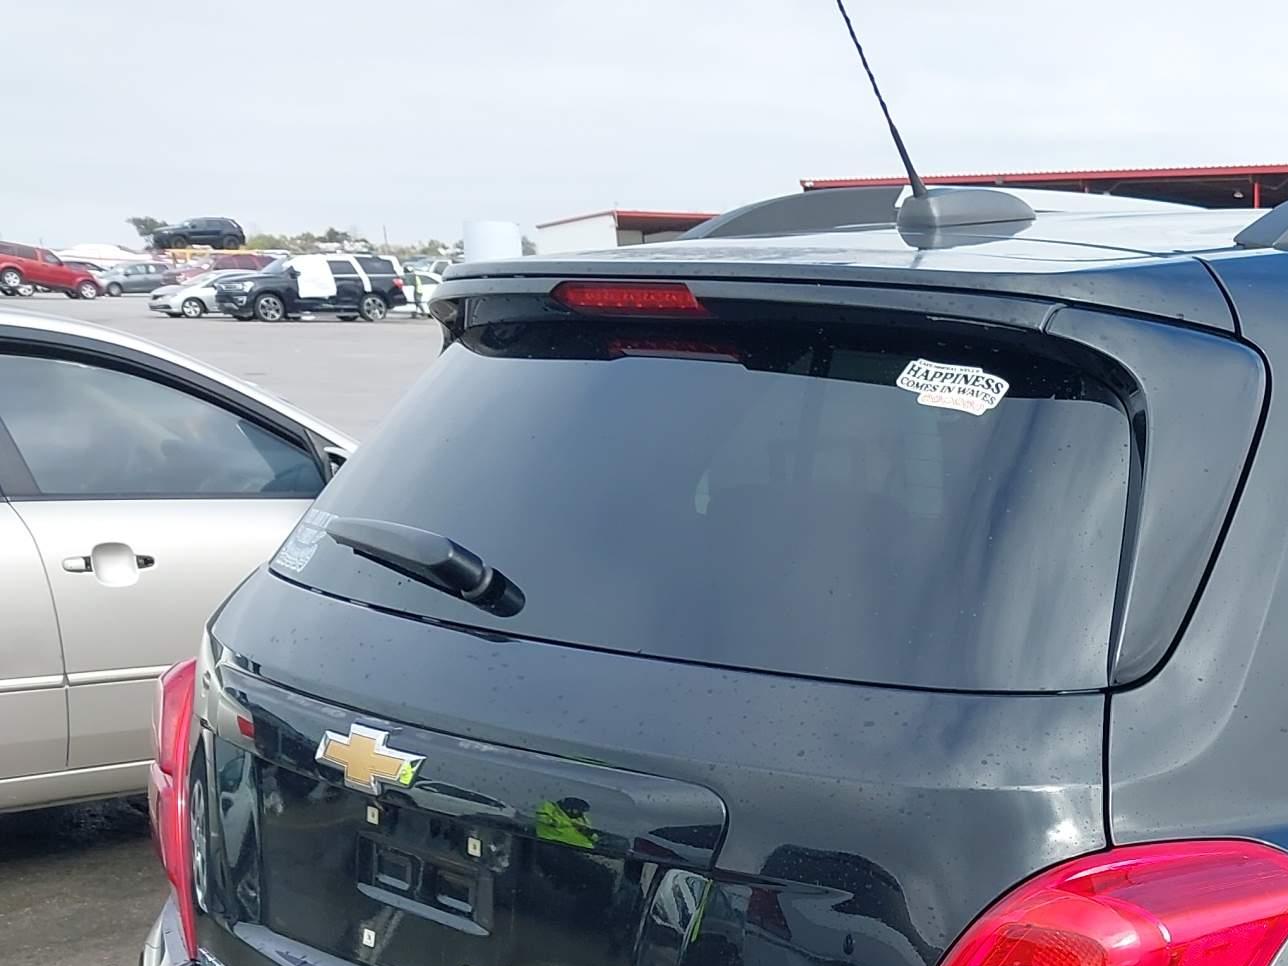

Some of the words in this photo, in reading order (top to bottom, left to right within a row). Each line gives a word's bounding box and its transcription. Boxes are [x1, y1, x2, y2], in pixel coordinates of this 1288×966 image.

[900, 376, 940, 393] COMES
[940, 384, 956, 394] IN
[957, 386, 997, 406] WAVES
[906, 363, 1004, 395] HAPPINESS
